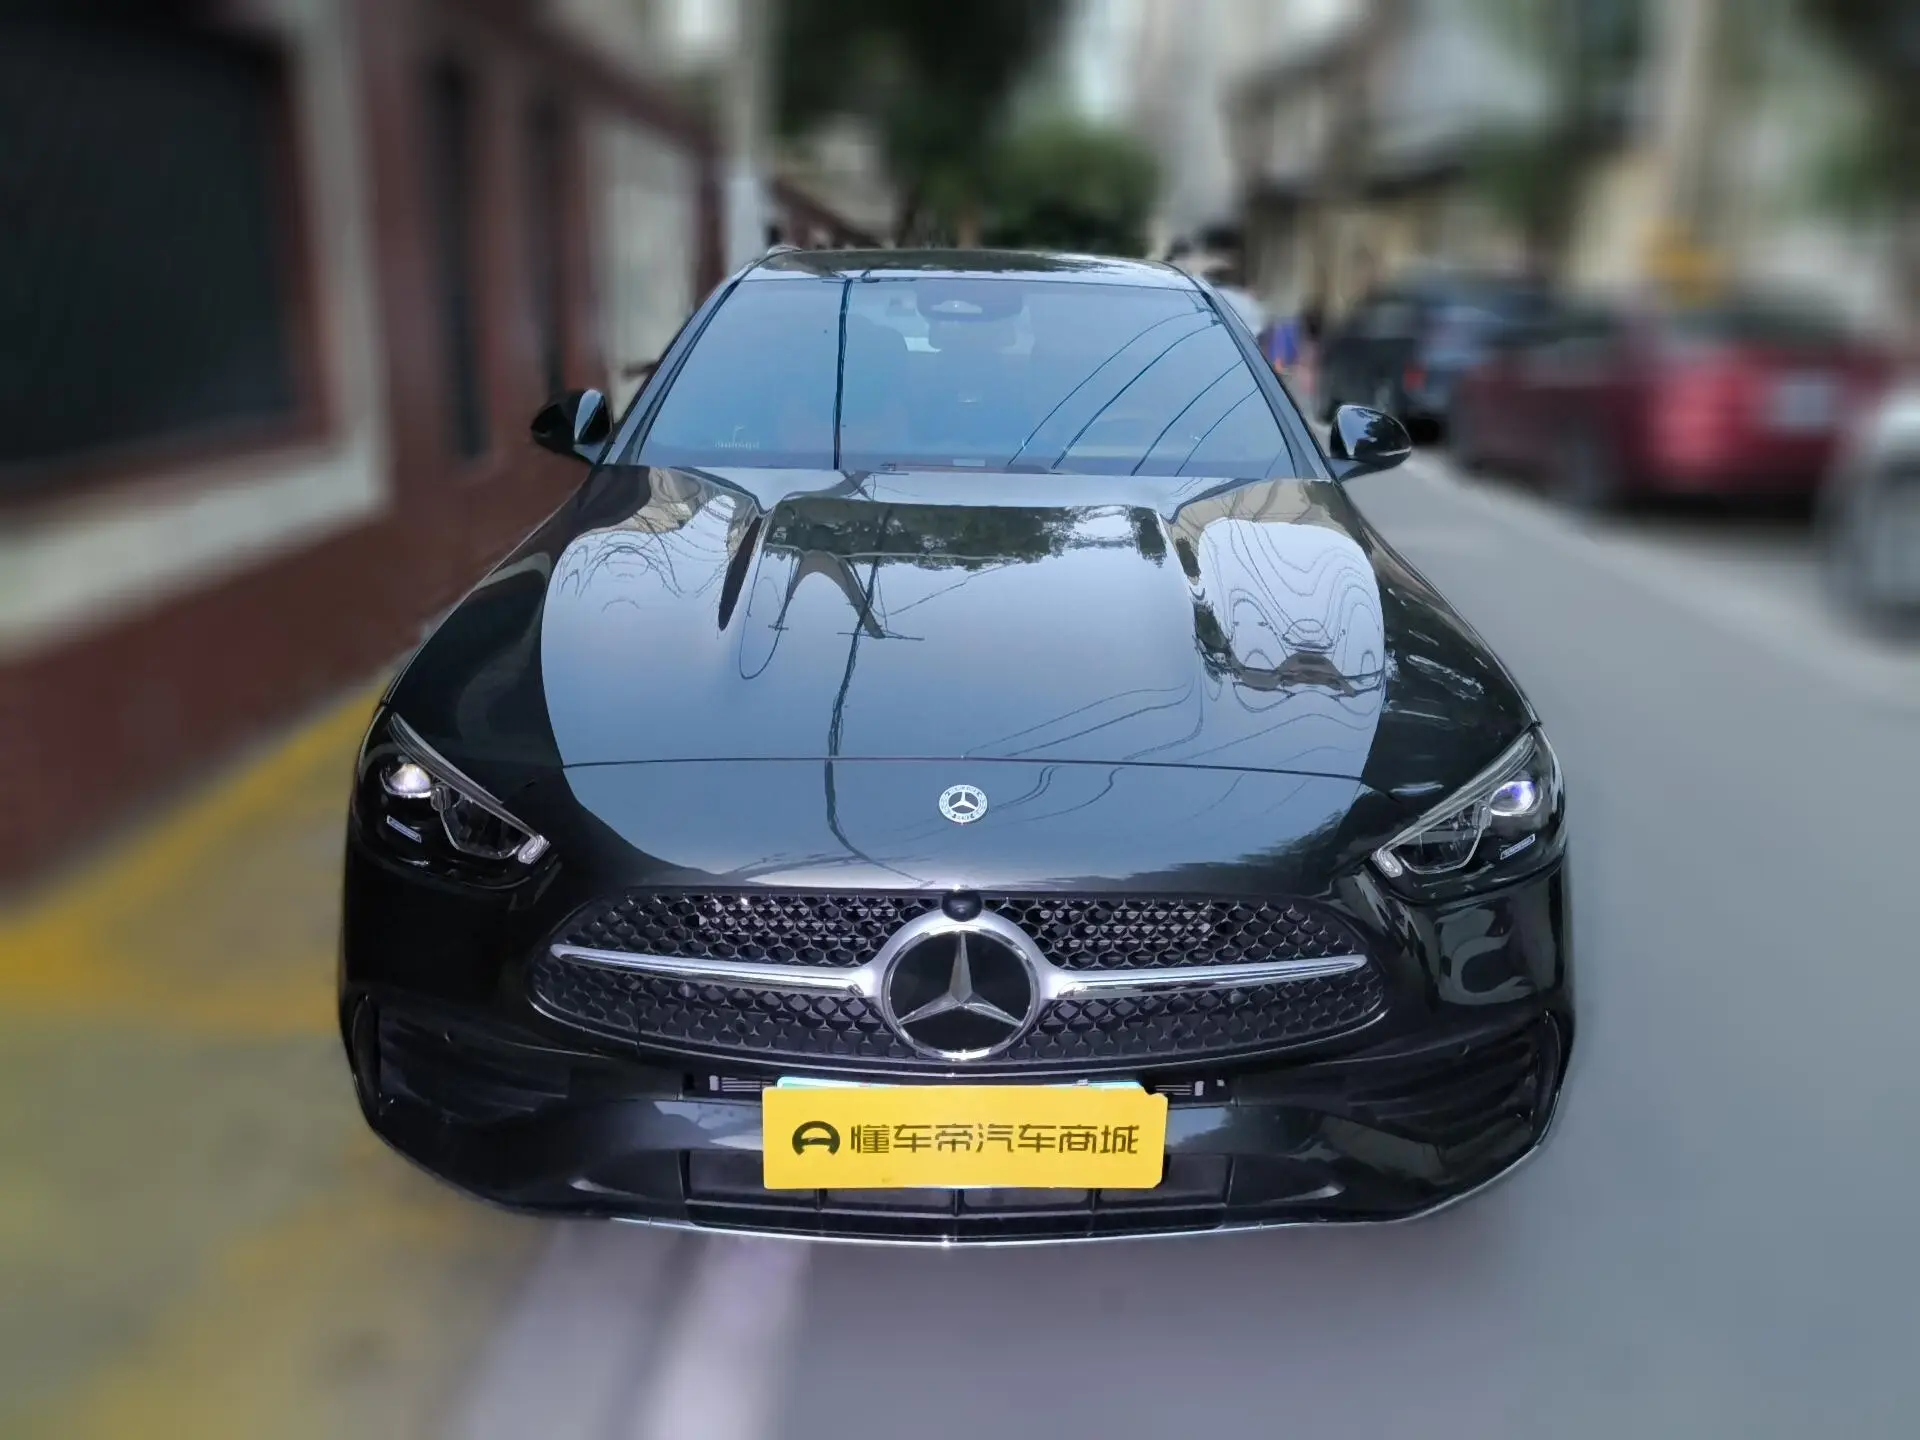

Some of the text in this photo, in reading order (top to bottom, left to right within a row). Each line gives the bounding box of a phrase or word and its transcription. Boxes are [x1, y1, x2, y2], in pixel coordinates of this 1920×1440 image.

[851, 1123, 1140, 1154] 懂车帝汽车商城
